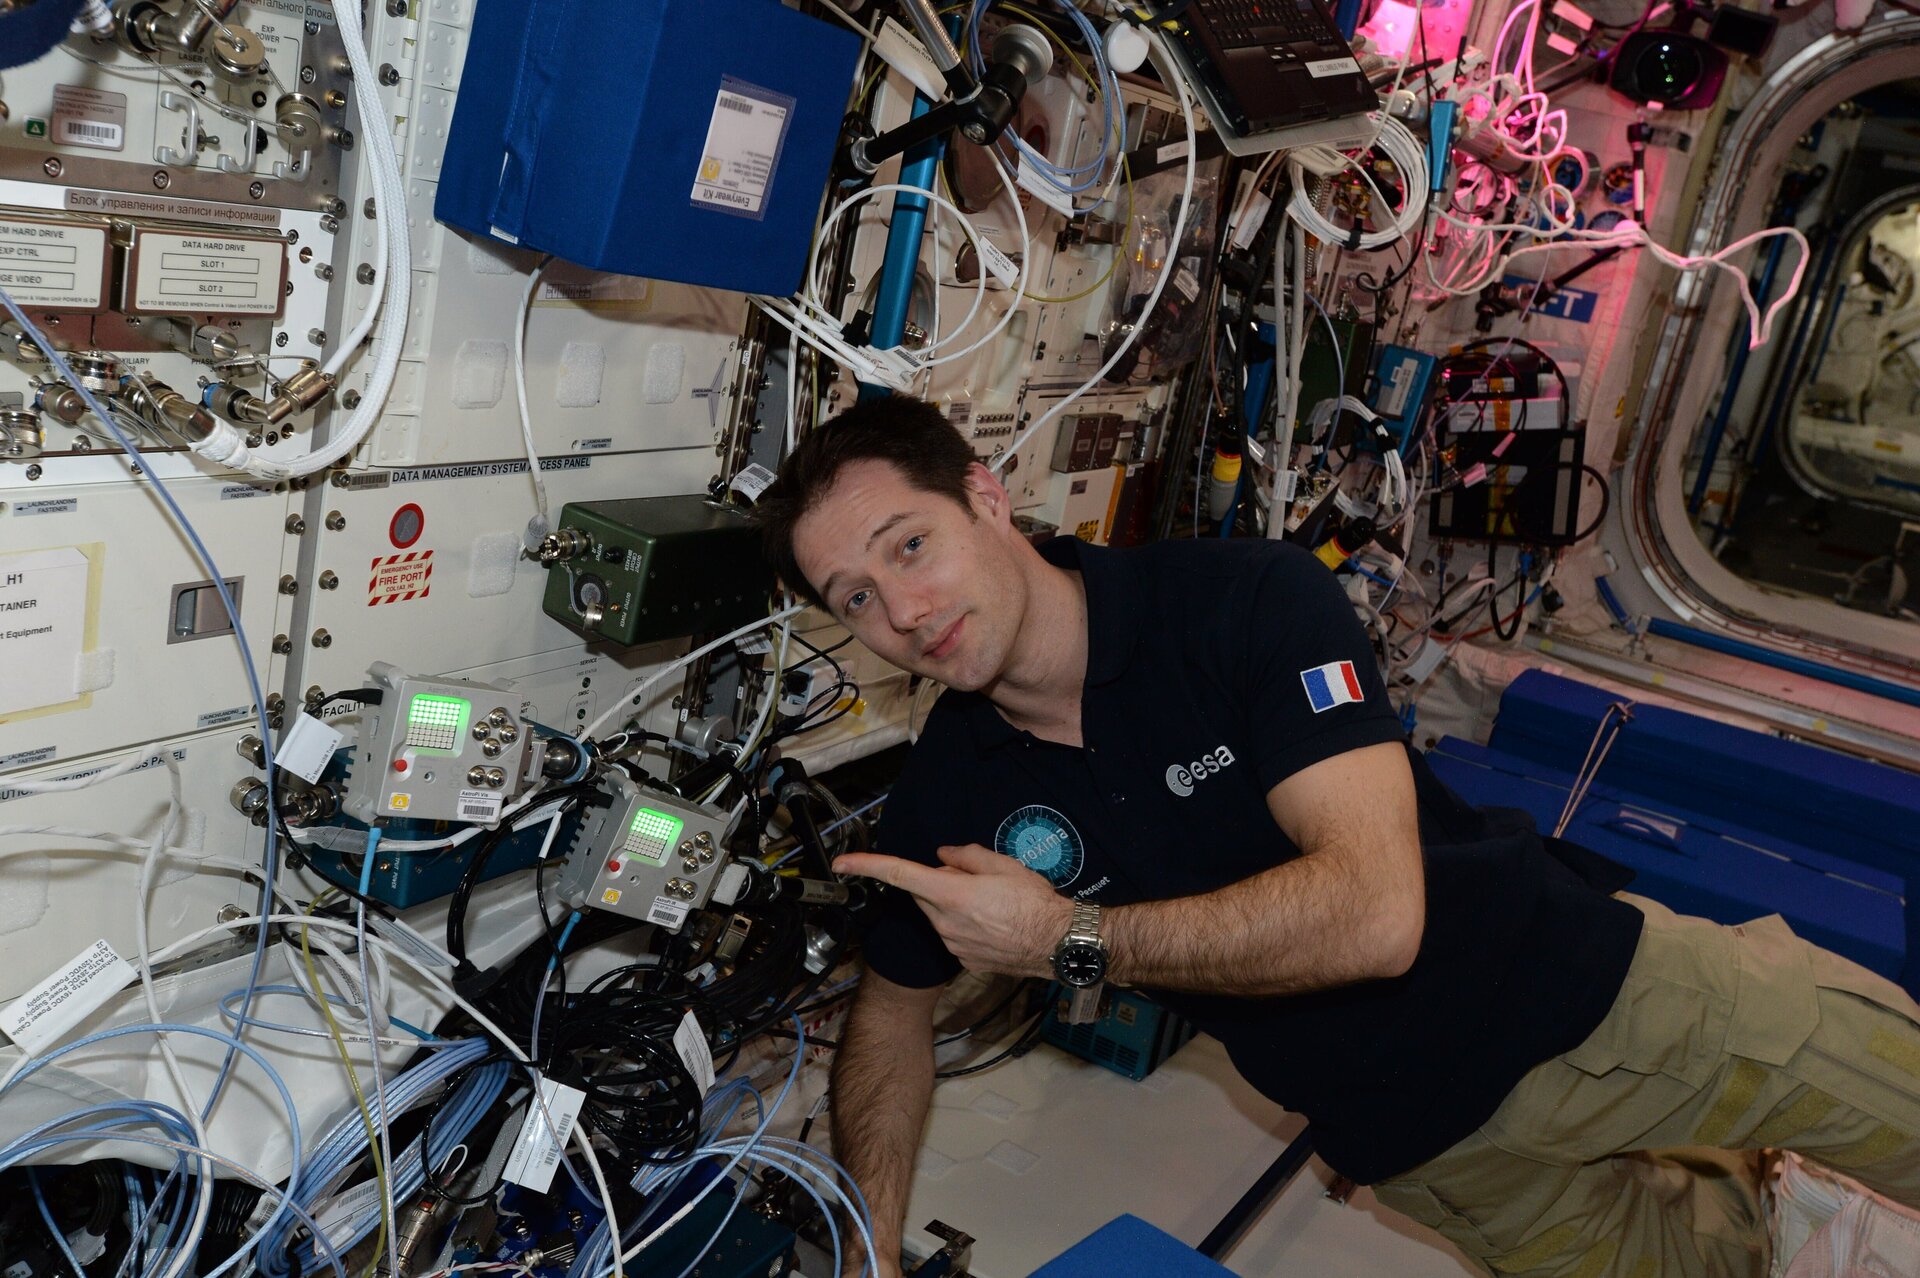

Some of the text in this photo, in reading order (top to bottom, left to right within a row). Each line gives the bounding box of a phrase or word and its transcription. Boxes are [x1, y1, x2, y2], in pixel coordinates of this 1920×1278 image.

[261, 25, 275, 33] EXP
[702, 188, 751, 207] Everywear Kit
[70, 193, 98, 206] Блок
[101, 196, 165, 212] управления
[176, 206, 212, 216] записи
[214, 209, 276, 222] информации
[12, 228, 36, 237] HARD
[39, 230, 64, 239] DRIVE
[17, 247, 39, 257] CTRL
[182, 240, 245, 251] DATA HARD DRIVE
[201, 260, 220, 268] SLOT
[16, 275, 42, 284] VIDEO
[198, 284, 218, 293] SLOT
[392, 470, 420, 482] DATA
[421, 465, 489, 481] MANAGEMENT
[491, 463, 526, 476] SYSTEM
[564, 457, 590, 469] PANEL
[37, 505, 68, 513] FASTENER
[595, 543, 603, 562] OUTPUT
[380, 565, 412, 575] EMERGENCY
[379, 571, 423, 586] FIRE PORT
[619, 612, 628, 628] POWER
[6, 625, 52, 639] Equipment
[1190, 745, 1235, 780] esa
[1077, 876, 1111, 899] Pesquet
[656, 897, 672, 905] AstroPi
[95, 940, 104, 950] J2
[104, 951, 115, 959] To
[88, 957, 105, 971] A31p
[26, 946, 109, 1009] A31p 120VDC Power Supply
[12, 955, 119, 1036] Enhanced A31p 16VDC Power Cable
[49, 984, 69, 1001] Power
[25, 999, 49, 1018] Supply
[17, 1016, 25, 1024] or
